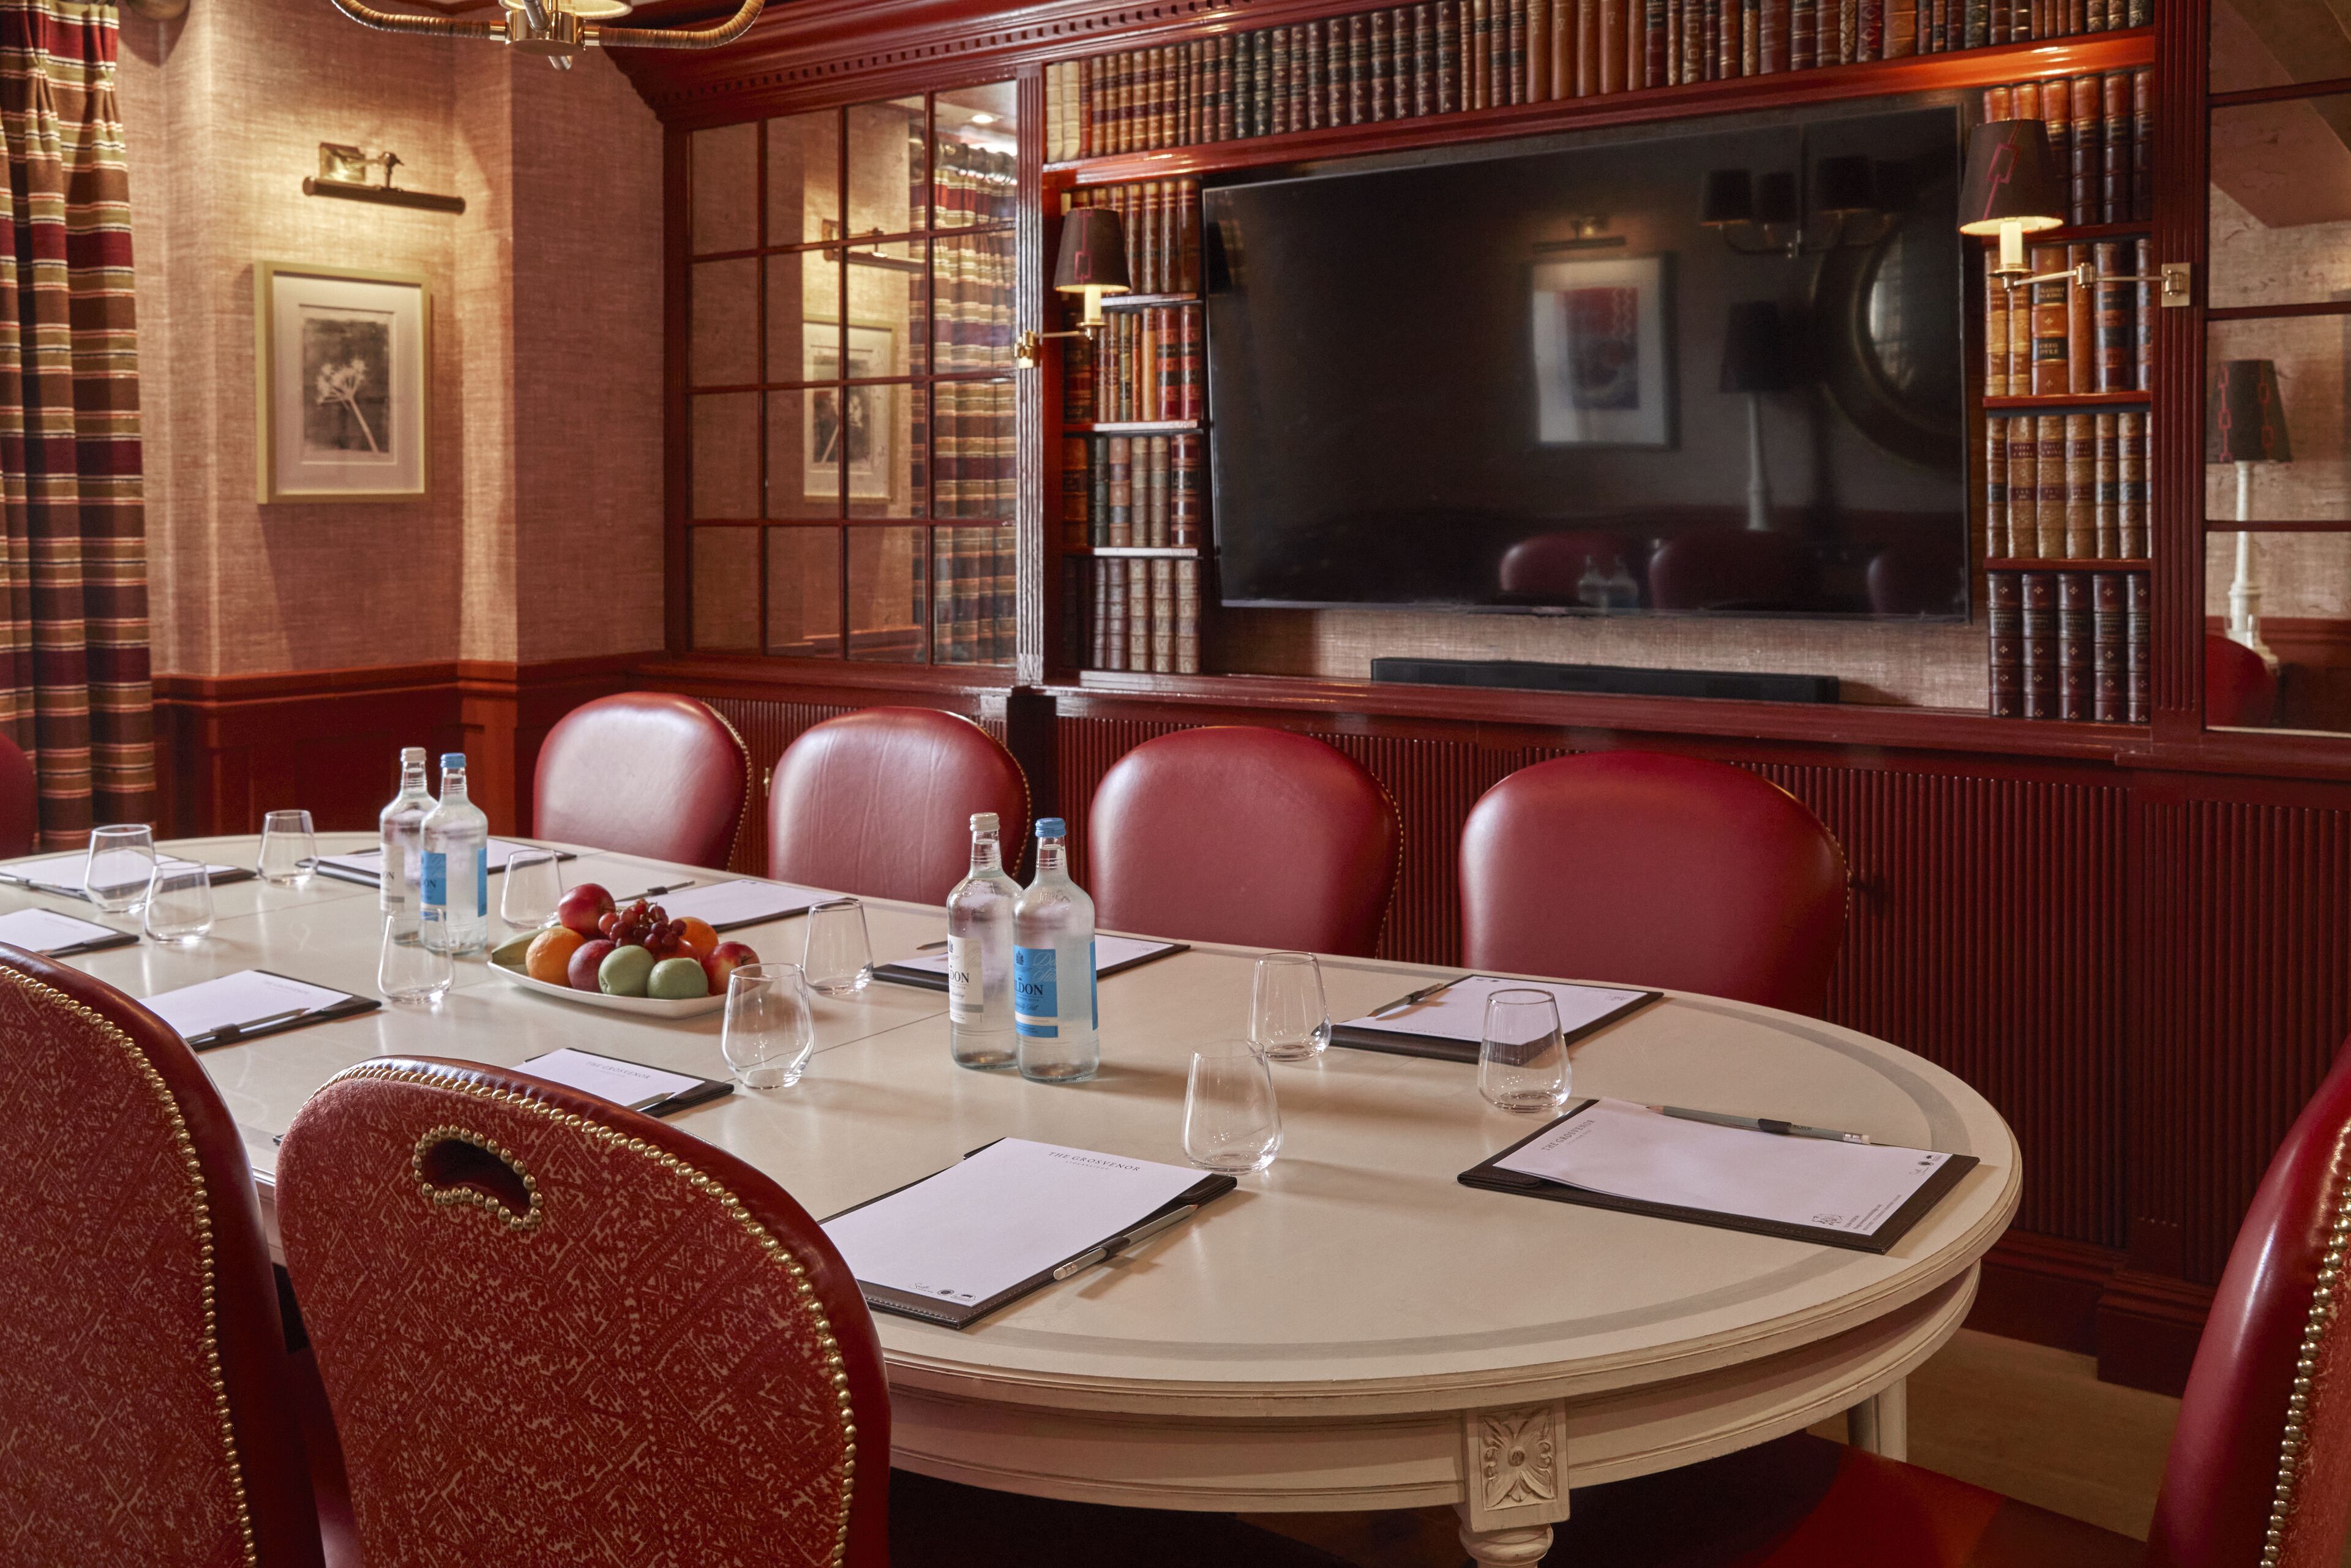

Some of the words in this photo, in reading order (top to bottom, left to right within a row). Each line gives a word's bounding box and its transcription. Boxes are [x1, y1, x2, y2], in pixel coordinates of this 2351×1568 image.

[1541, 1141, 1559, 1151] THE
[1555, 1119, 1595, 1143] GROSVENOR
[1071, 1156, 1141, 1171] GROSVENOR
